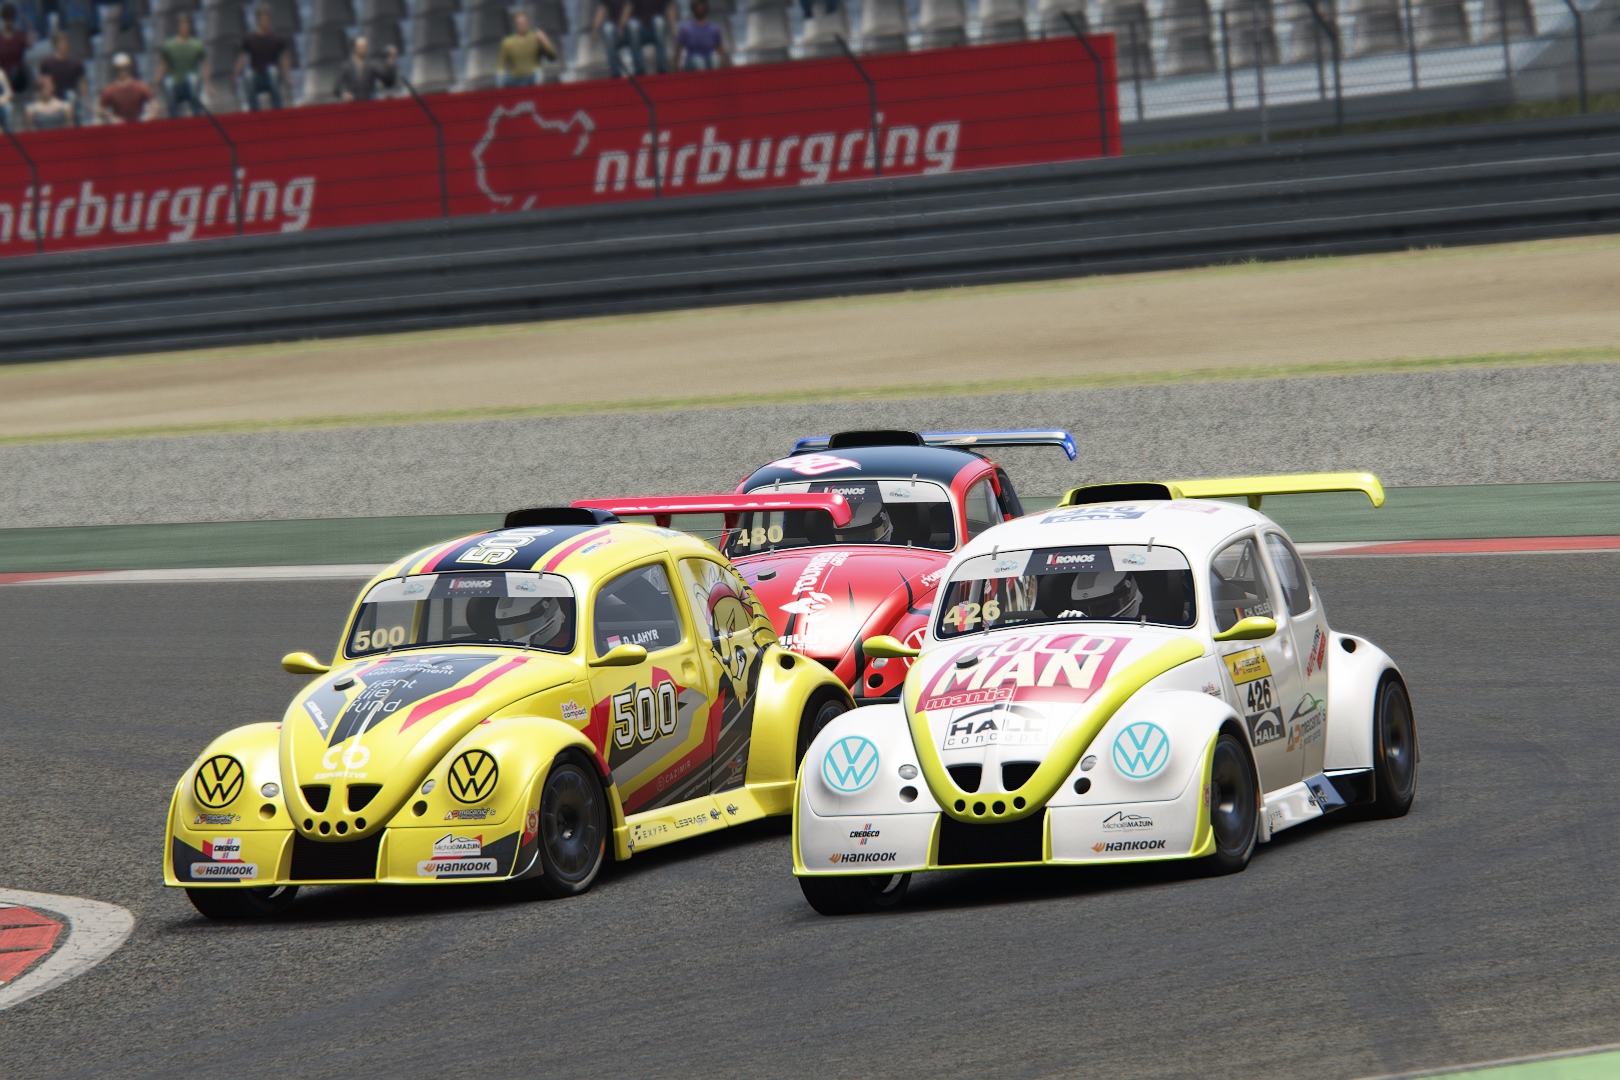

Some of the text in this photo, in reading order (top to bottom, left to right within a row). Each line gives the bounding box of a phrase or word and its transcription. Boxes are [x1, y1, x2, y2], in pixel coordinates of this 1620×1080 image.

[594, 112, 961, 193] nürburgring
[455, 528, 554, 565] 500
[737, 525, 784, 547] 480
[1046, 551, 1096, 565] KRONOS
[449, 576, 493, 589] KRONOS
[943, 599, 1001, 627] 426
[354, 626, 405, 651] 500
[632, 629, 660, 645] LAHYR
[930, 652, 1104, 697] MAN
[925, 687, 1014, 710] mania
[1247, 679, 1272, 713] 426
[613, 680, 679, 750] 500
[950, 719, 1042, 737] HALL
[1255, 726, 1280, 745] HALL
[947, 732, 1041, 747] concept
[849, 830, 880, 838] CREDECO
